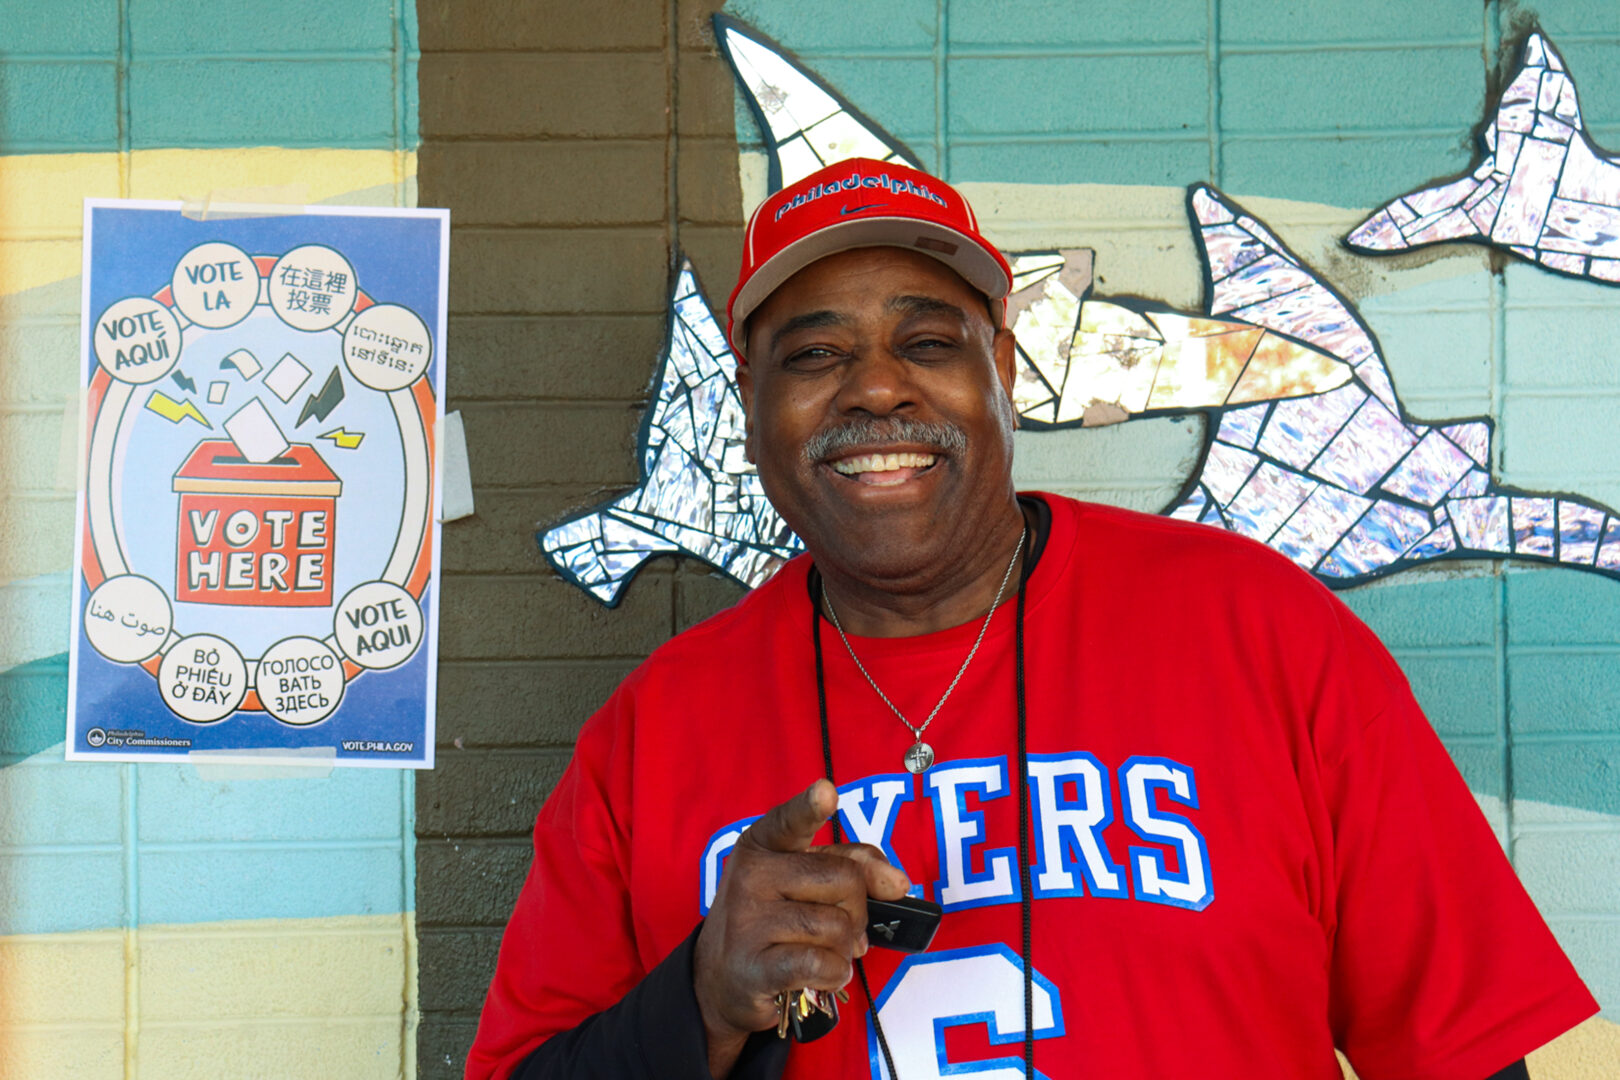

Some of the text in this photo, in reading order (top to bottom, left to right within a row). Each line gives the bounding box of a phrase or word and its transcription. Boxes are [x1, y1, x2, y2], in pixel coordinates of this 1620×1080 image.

[185, 260, 243, 285] VOTE
[280, 264, 348, 295] 在這裡
[203, 290, 231, 311] LA
[286, 289, 333, 316] 投票
[102, 310, 165, 341] VOTE
[115, 331, 170, 371] AQUÍ
[188, 509, 327, 549] VOTE
[187, 550, 325, 592] HERE
[90, 599, 166, 637] صوت هنا
[345, 598, 408, 629] VOTE
[357, 624, 412, 656] AQUI
[263, 654, 334, 677] ГОЛОСО
[279, 675, 322, 693] ВАТЬ
[275, 693, 330, 715] ЗДЕСЬ
[106, 737, 191, 747] City Commissioners
[342, 741, 413, 752] VOTE.PHILA.GOV
[700, 751, 1215, 916] XERS
